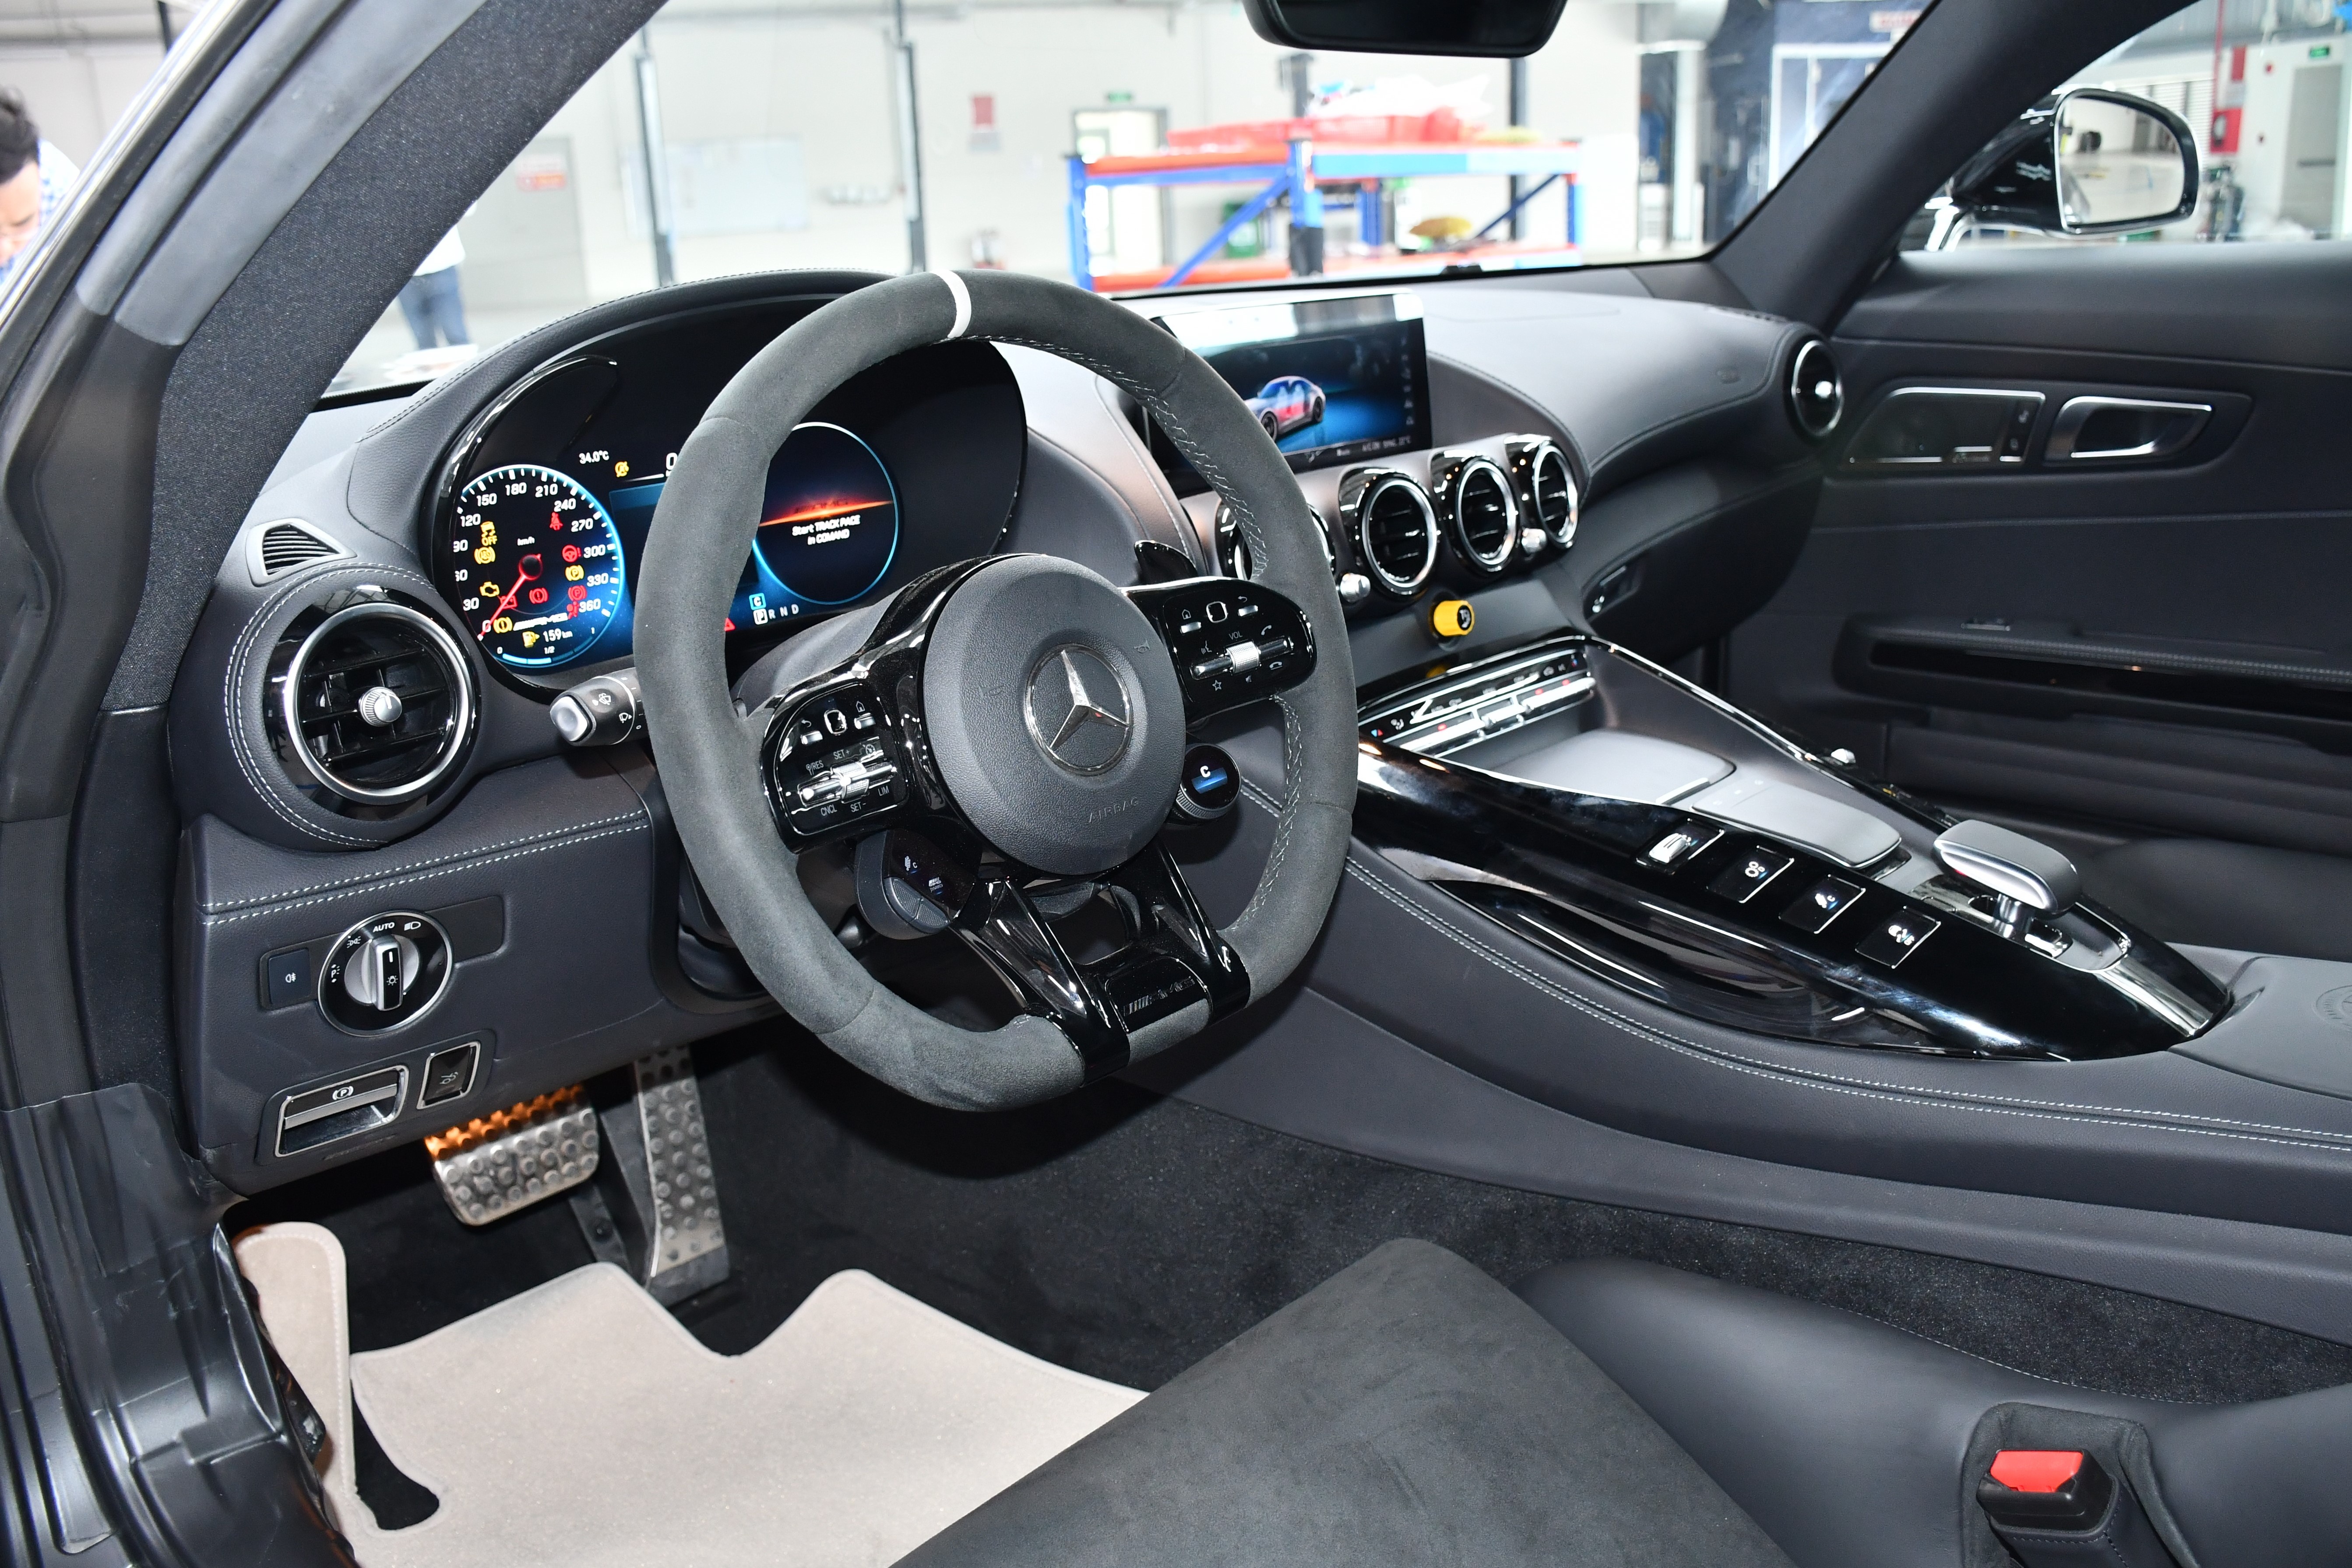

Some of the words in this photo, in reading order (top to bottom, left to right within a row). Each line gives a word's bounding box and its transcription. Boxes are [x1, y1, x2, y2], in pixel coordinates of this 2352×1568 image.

[579, 450, 609, 464] 34.0°C
[505, 482, 527, 496] 180
[535, 484, 558, 498] 210
[476, 493, 497, 506] 150
[554, 498, 576, 512] 240
[461, 513, 481, 527] 120
[571, 518, 593, 532] 270
[792, 524, 814, 536] Start
[815, 519, 840, 531] TRACK
[840, 515, 860, 527] PACE
[482, 535, 497, 546] OFF
[517, 536, 535, 546] km/h
[816, 529, 850, 543] COMAND
[453, 539, 468, 552] 90
[584, 545, 606, 558] 300
[587, 573, 609, 587] 330
[463, 598, 479, 611] 30
[579, 598, 601, 612] 360
[768, 609, 776, 619] R
[780, 606, 788, 617] N
[791, 604, 799, 614] D
[543, 628, 561, 642] 159
[1228, 630, 1243, 640] VOL
[544, 646, 555, 654] 1/2
[833, 749, 845, 760] SET
[1200, 766, 1211, 777] C
[877, 785, 890, 796] LIM
[820, 804, 838, 816] CNCL
[850, 802, 862, 813] SET
[373, 922, 395, 933] AUTO
